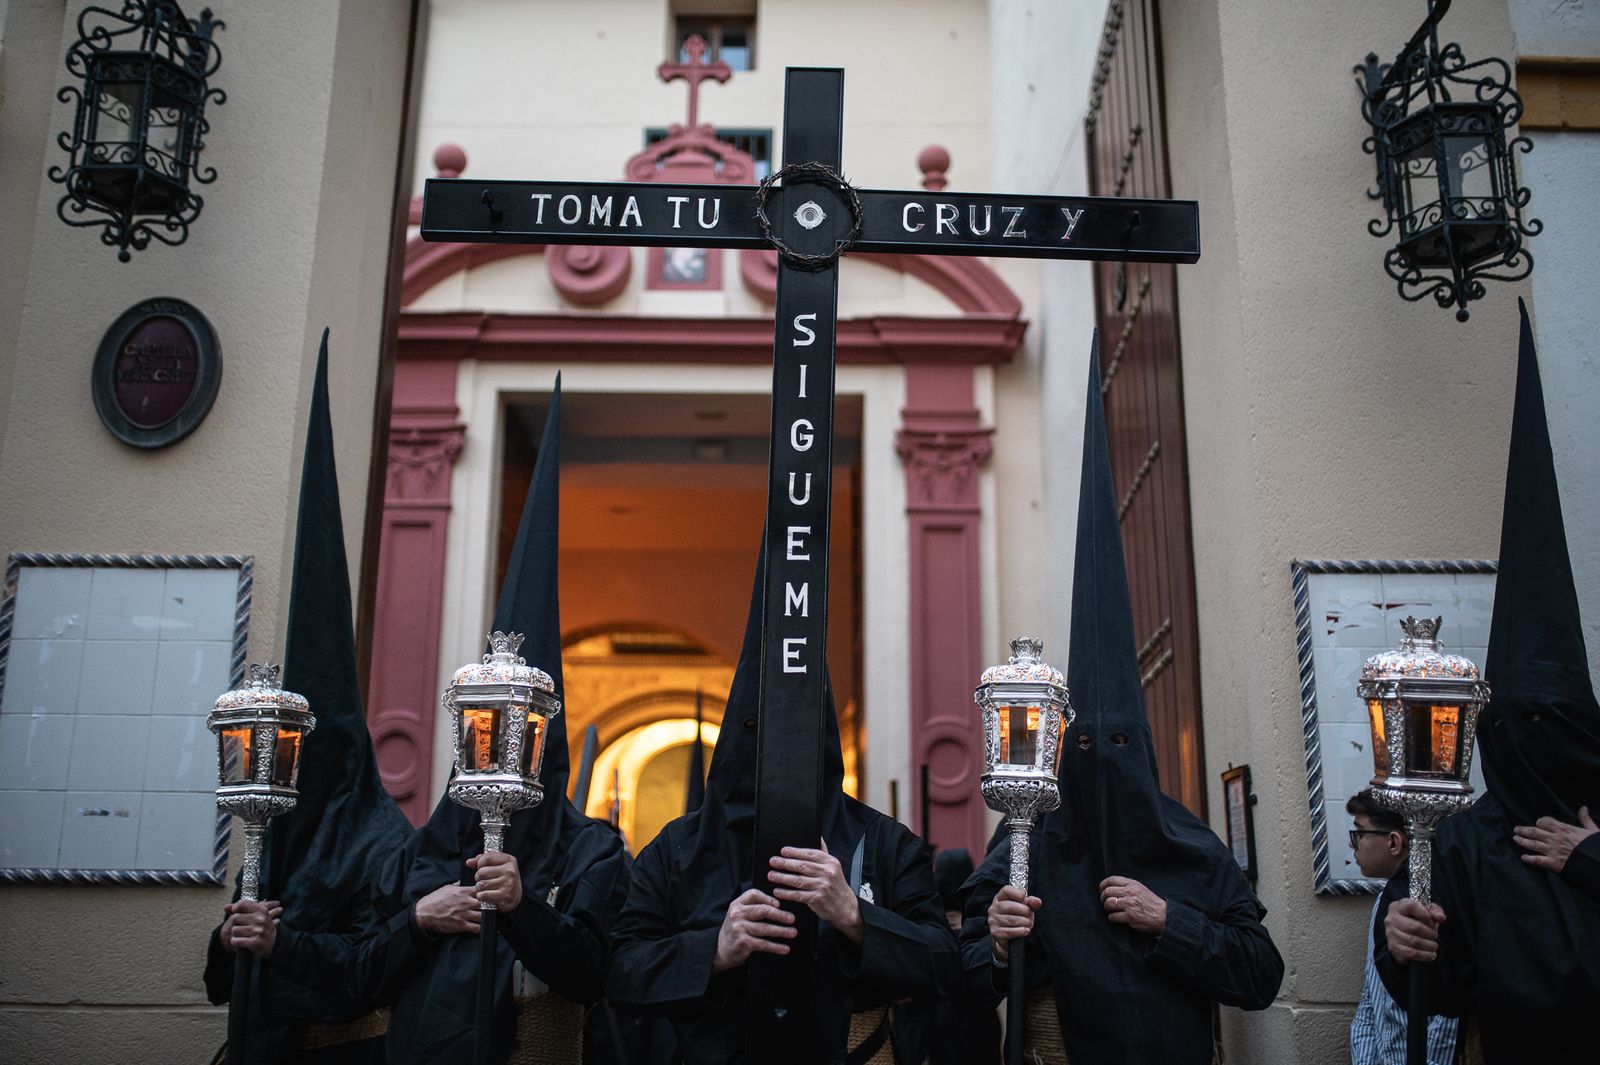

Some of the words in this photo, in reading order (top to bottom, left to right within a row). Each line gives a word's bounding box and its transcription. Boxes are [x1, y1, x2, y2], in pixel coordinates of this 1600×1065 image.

[531, 193, 643, 227] TOMA
[667, 197, 721, 229] TU
[902, 202, 1027, 240] CRUZ
[1060, 208, 1085, 240] Y
[782, 312, 817, 674] SIGUEME
